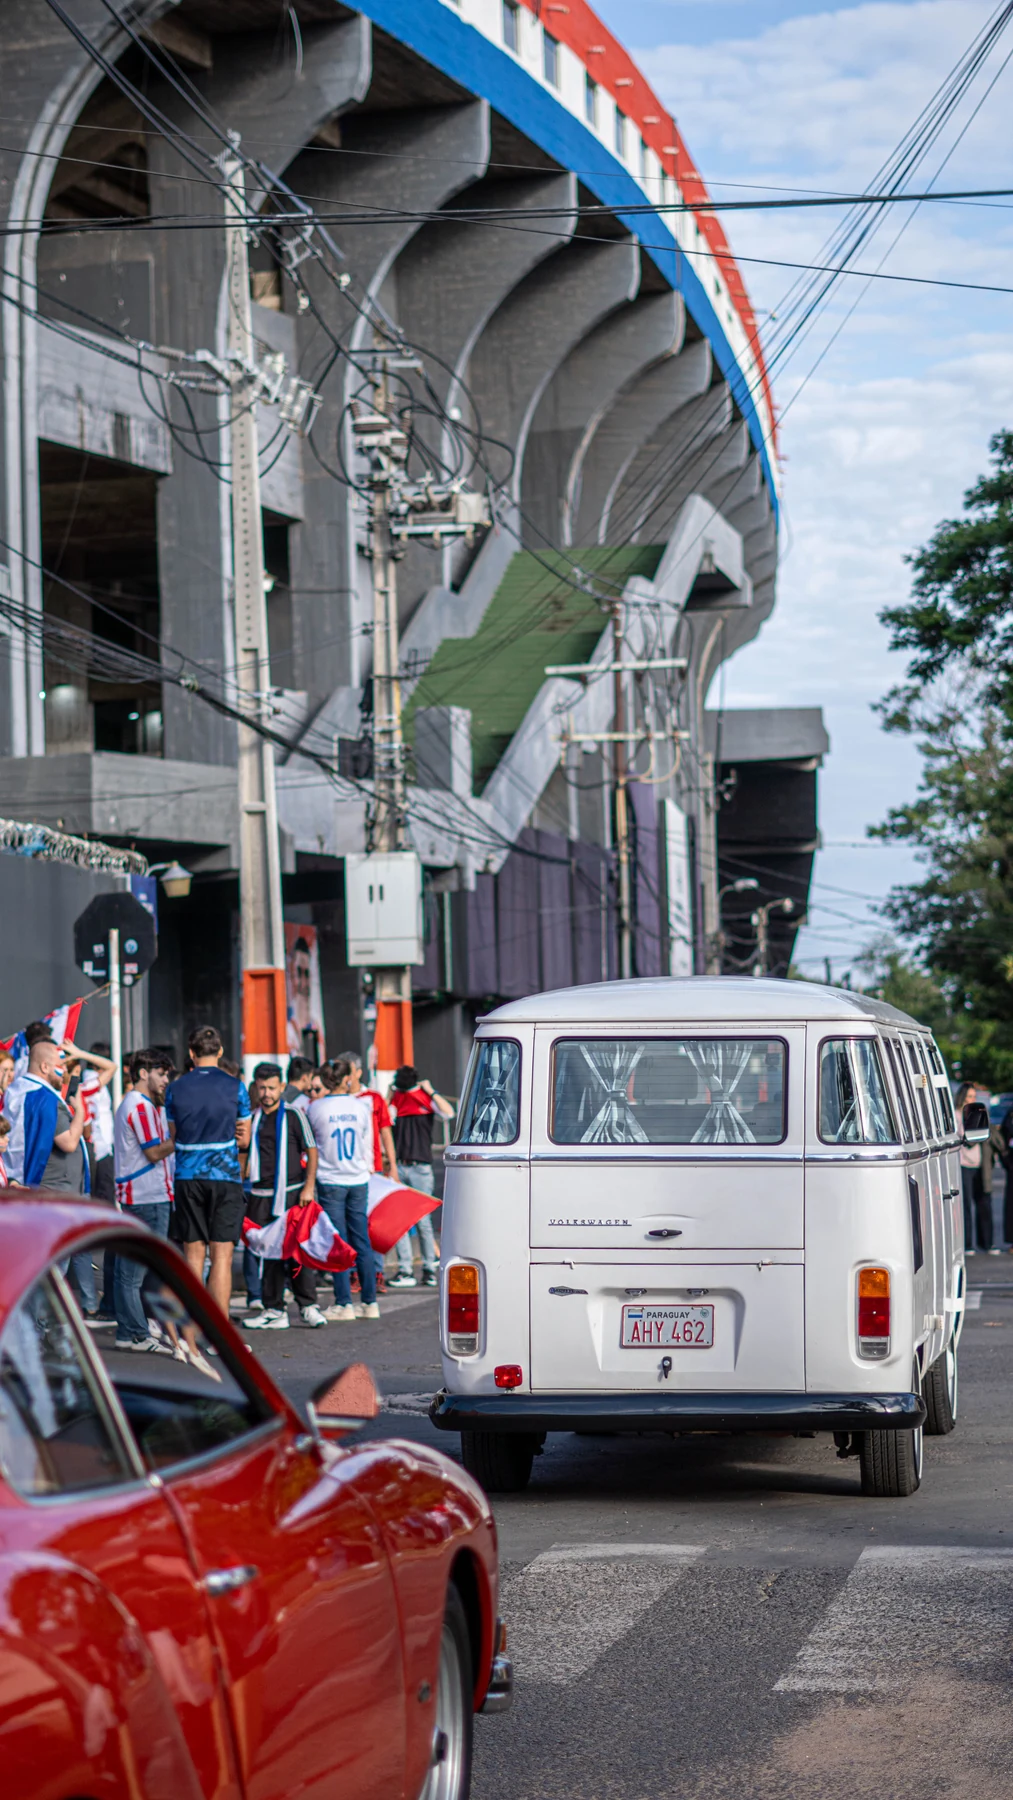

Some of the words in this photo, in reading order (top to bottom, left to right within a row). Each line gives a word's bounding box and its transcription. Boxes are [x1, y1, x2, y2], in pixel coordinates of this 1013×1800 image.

[331, 1127, 355, 1161] 10
[646, 1311, 690, 1319] PARAGUAY
[631, 1321, 664, 1342] AHY
[671, 1321, 705, 1342] 462
